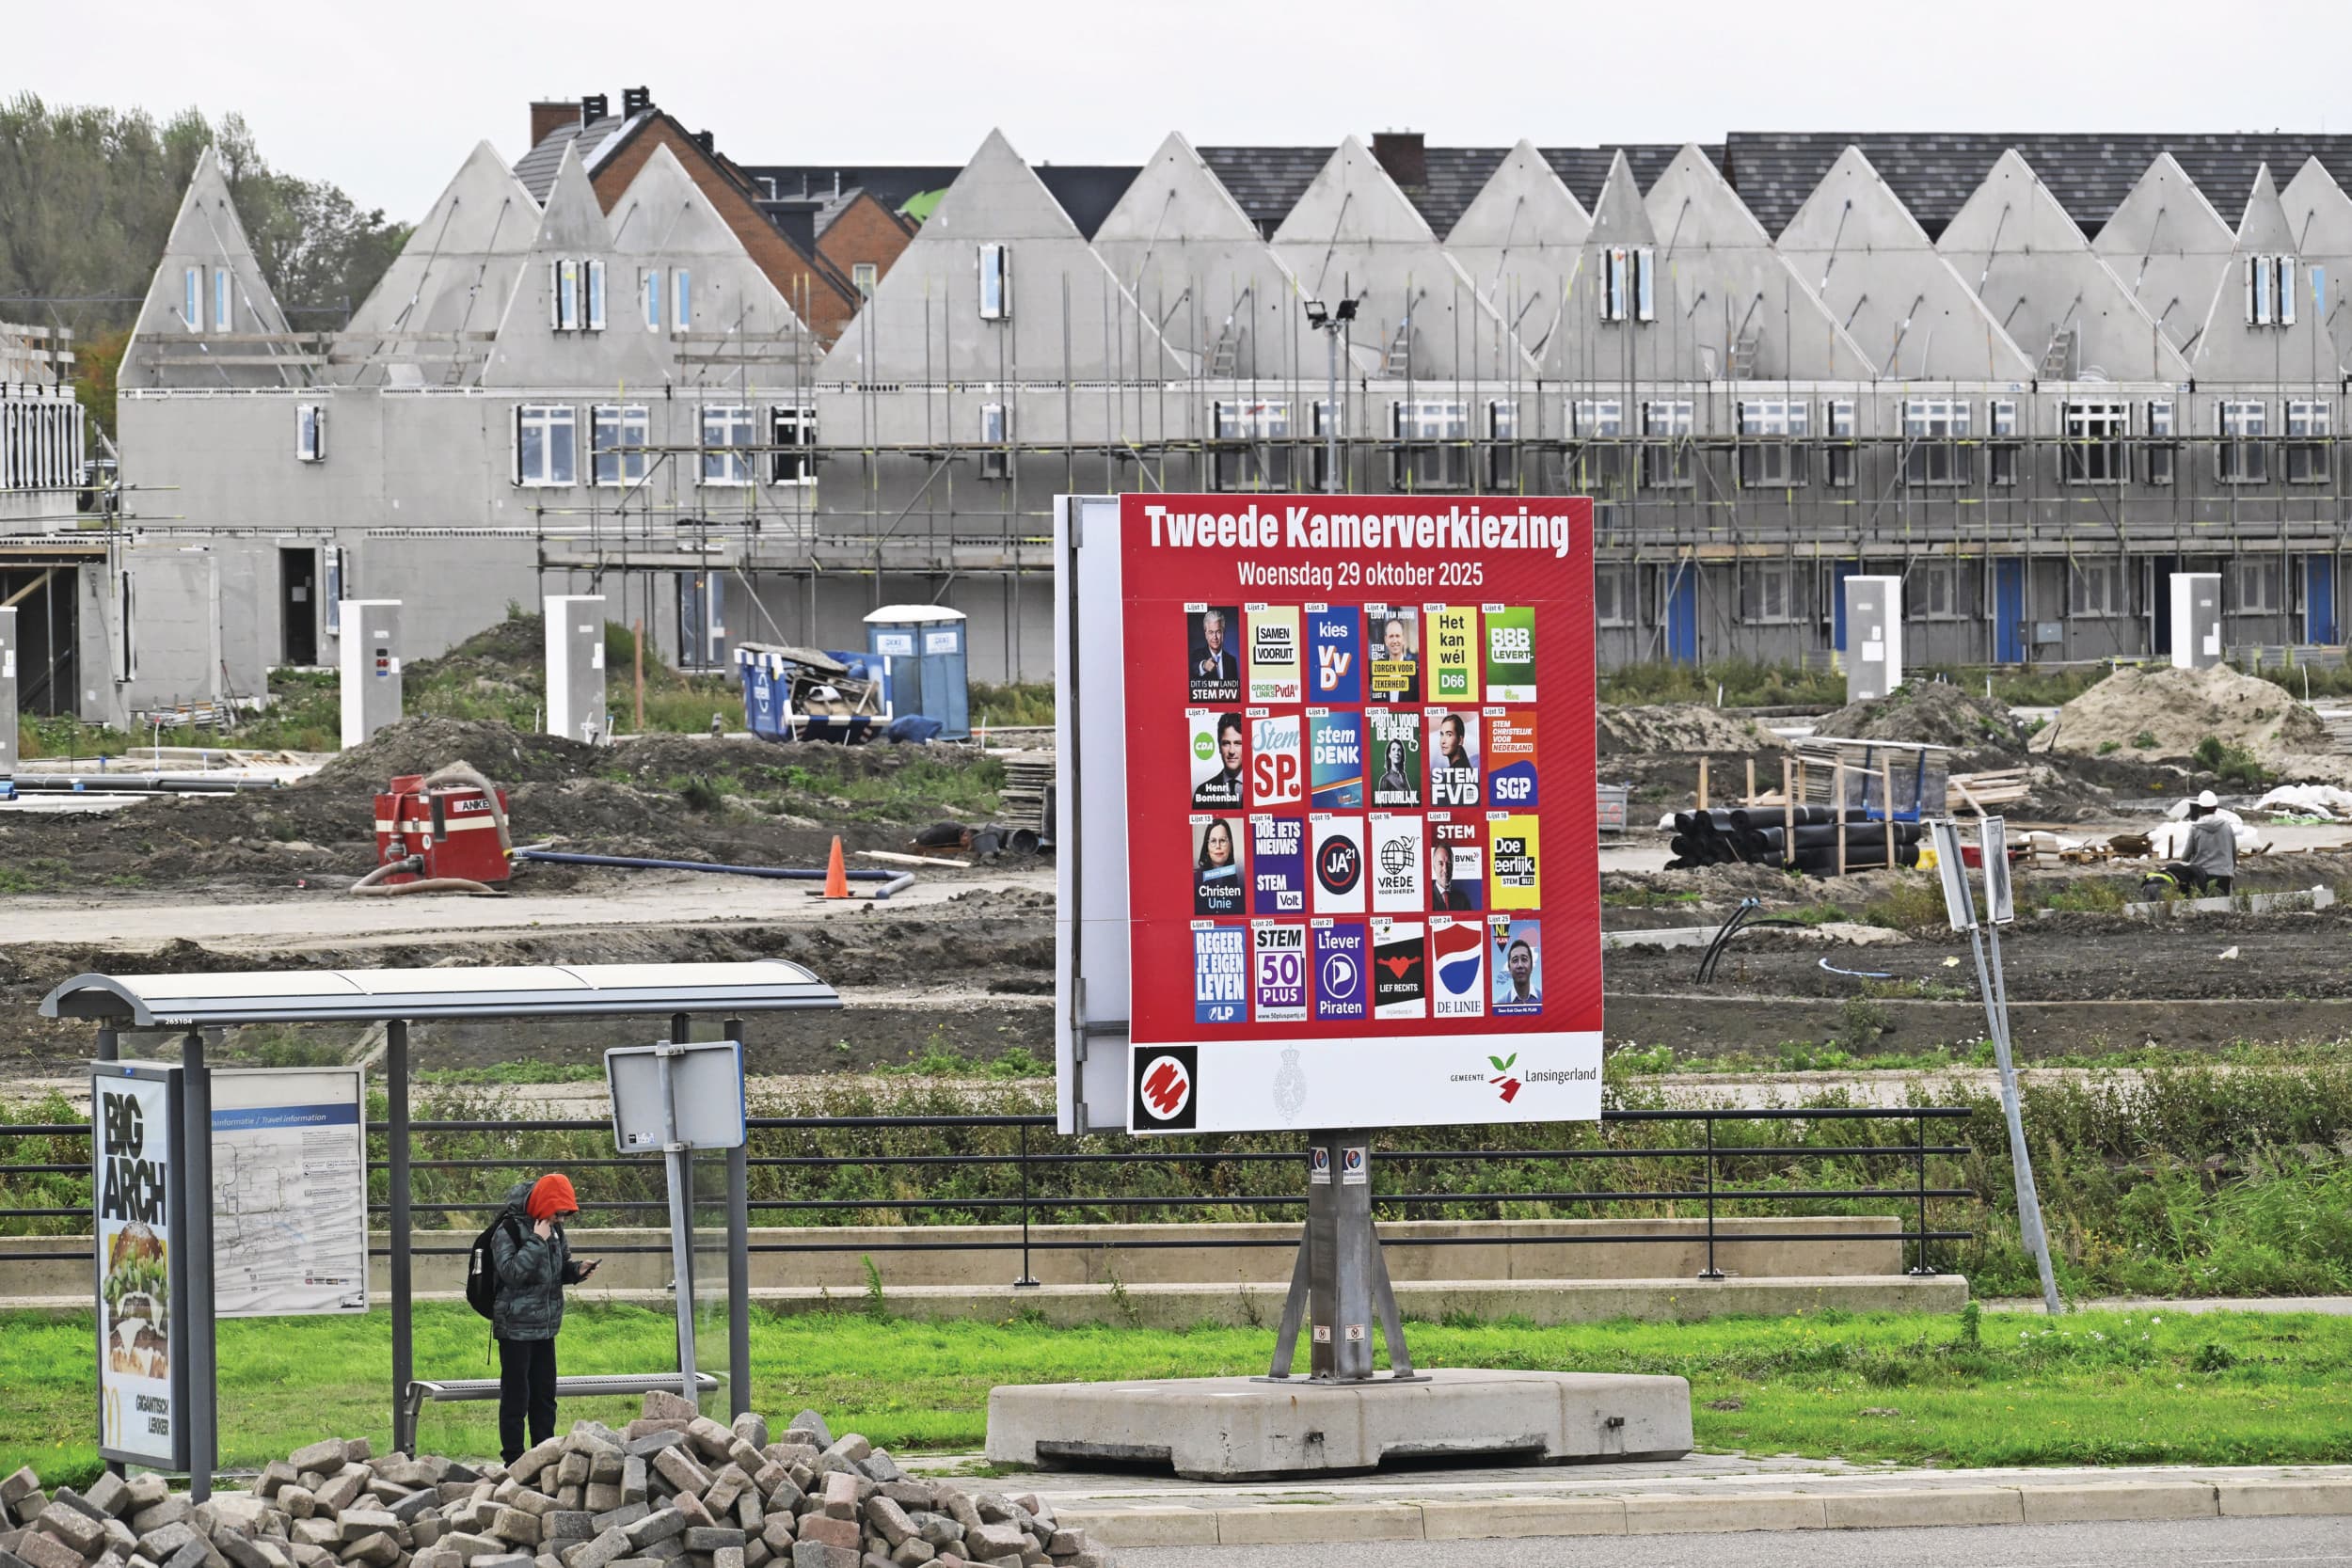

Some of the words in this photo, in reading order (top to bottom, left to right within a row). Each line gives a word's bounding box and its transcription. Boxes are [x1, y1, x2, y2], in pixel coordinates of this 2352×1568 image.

[1145, 505, 1279, 548] Tweede
[1287, 506, 1568, 558] Kamerverkiezing
[1238, 562, 1332, 591] Woensdag
[1338, 562, 1360, 586] 29
[1366, 562, 1435, 586] oktober
[1438, 562, 1484, 586] 2025
[1319, 621, 1348, 637] kies
[1439, 615, 1465, 629] Het
[1260, 627, 1290, 639] SAMEN
[1440, 632, 1465, 646] kan
[1490, 627, 1530, 647] BBB
[1257, 648, 1294, 658] VOORUIT
[1440, 649, 1465, 664] wél
[1318, 645, 1352, 690] VVD
[1374, 664, 1396, 673] ZORGEN
[1398, 664, 1414, 673] VOOR
[1374, 680, 1407, 689] ZEKERHEID!
[1441, 674, 1465, 688] D66
[1192, 689, 1216, 699] STEM
[1218, 689, 1238, 699] PVV
[1275, 684, 1295, 697] PvdA
[1399, 713, 1420, 727] VOOR
[1252, 720, 1300, 752] Stem
[1316, 725, 1356, 743] stem
[1376, 727, 1387, 740] DE
[1388, 727, 1414, 740] DIEREN
[1195, 741, 1214, 750] CDA
[1313, 746, 1359, 764] DENK
[1432, 768, 1479, 784] STEM
[1205, 783, 1229, 792] Henri
[1432, 784, 1479, 805] FVD
[1496, 777, 1532, 800] SGP
[1196, 793, 1240, 802] Bontenbal
[462, 800, 490, 811] ANKE
[1255, 821, 1276, 838] DOE
[1277, 821, 1300, 838] IETS
[1437, 825, 1475, 839] STEM
[1256, 839, 1297, 855] NIEUWS
[1494, 838, 1521, 853] Doe
[1327, 848, 1356, 873] JA21
[1494, 856, 1535, 875] eerlijk.
[1257, 875, 1287, 891] STEM
[1377, 876, 1414, 888] VREDE
[1199, 885, 1241, 896] Christen
[1208, 897, 1232, 909] Unie
[1279, 895, 1299, 906] Volt
[1257, 929, 1302, 947] STEM
[1496, 926, 1509, 936] NL
[1196, 932, 1244, 954] REGEER
[1318, 930, 1360, 949] Liever
[1197, 954, 1209, 974] JE
[1211, 954, 1244, 974] EIGEN
[1262, 954, 1299, 986] 50
[1197, 974, 1245, 1001] LEVEN
[1379, 984, 1393, 992] LIEF
[1393, 983, 1419, 992] RECHTS
[1263, 989, 1297, 1002] PLUS
[1320, 1001, 1362, 1015] Piraten
[1438, 1002, 1452, 1013] DE
[1454, 1001, 1481, 1013] LINIE
[1450, 1073, 1485, 1082] GEMEENTE
[1525, 1067, 1597, 1085] Lansingerland
[103, 1091, 143, 1159] BIG
[262, 1115, 282, 1123] Travel
[283, 1113, 326, 1122] information
[102, 1156, 167, 1227] ARCH
[135, 1393, 169, 1415] GIGANTISCH
[148, 1416, 169, 1436] LEKKER
